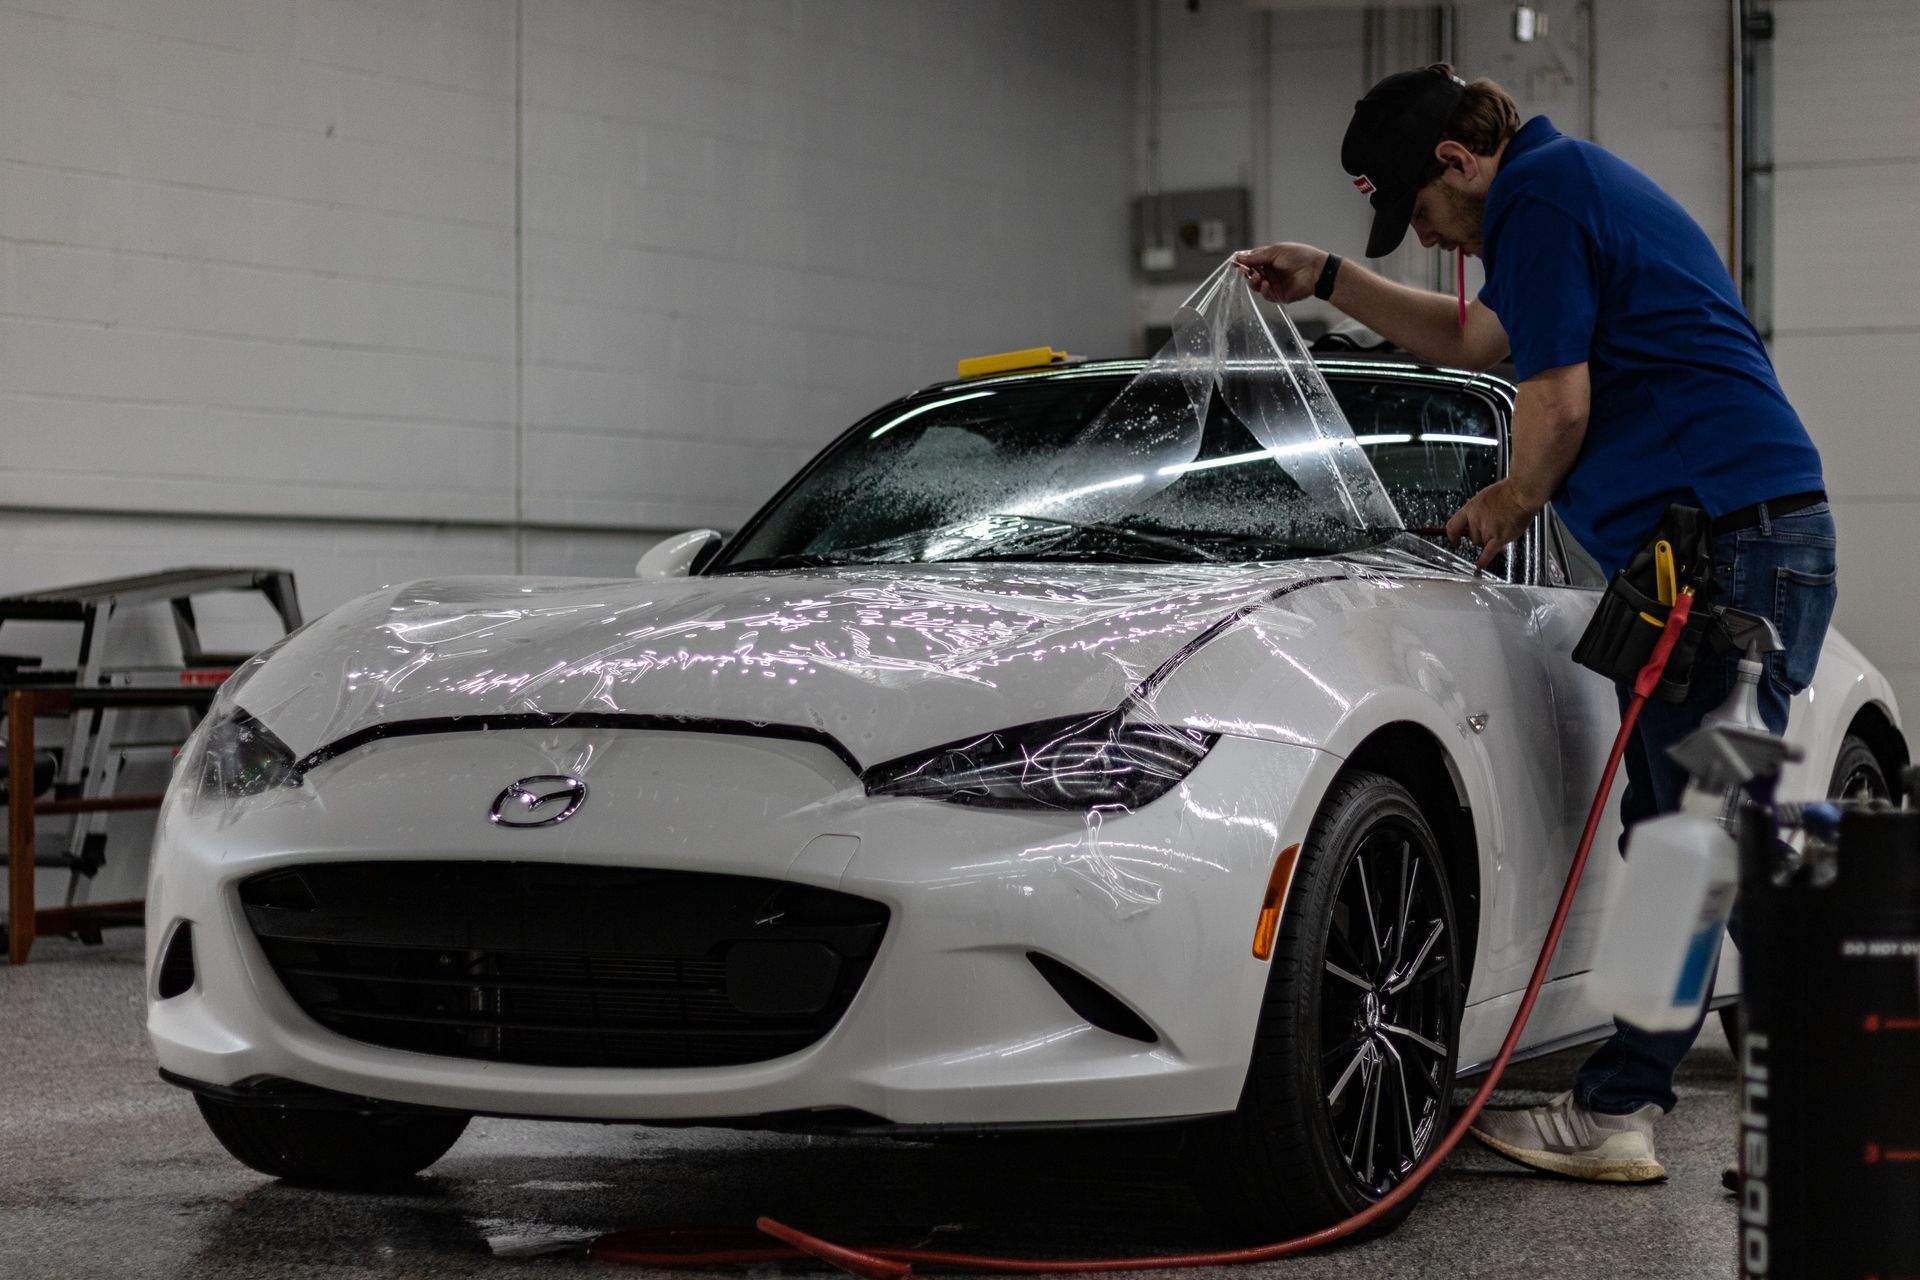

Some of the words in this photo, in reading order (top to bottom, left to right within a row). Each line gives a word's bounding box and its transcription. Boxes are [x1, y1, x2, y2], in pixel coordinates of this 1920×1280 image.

[1843, 941, 1867, 956] DO
[1869, 941, 1899, 956] NOT
[1742, 1032, 1769, 1280] obahn
